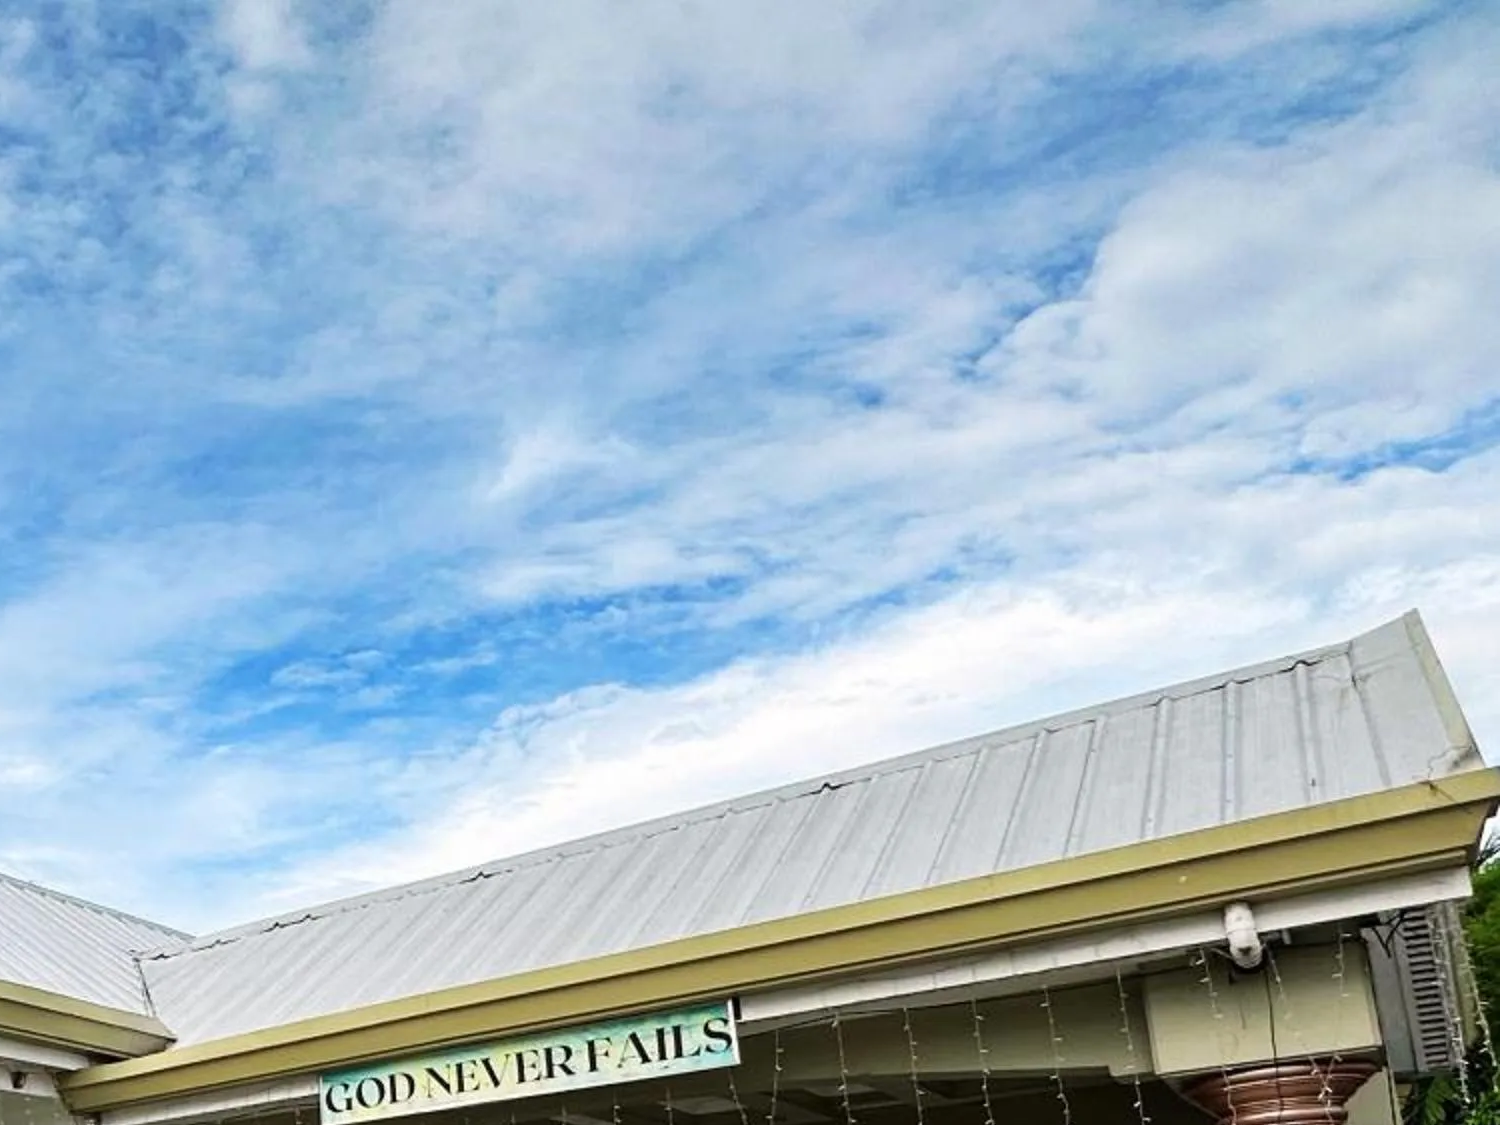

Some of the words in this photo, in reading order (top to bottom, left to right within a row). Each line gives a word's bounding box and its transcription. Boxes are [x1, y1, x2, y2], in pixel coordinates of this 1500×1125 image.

[325, 1071, 416, 1114] GOD
[425, 1044, 575, 1098] NEVER
[586, 1016, 734, 1072] FAILS
